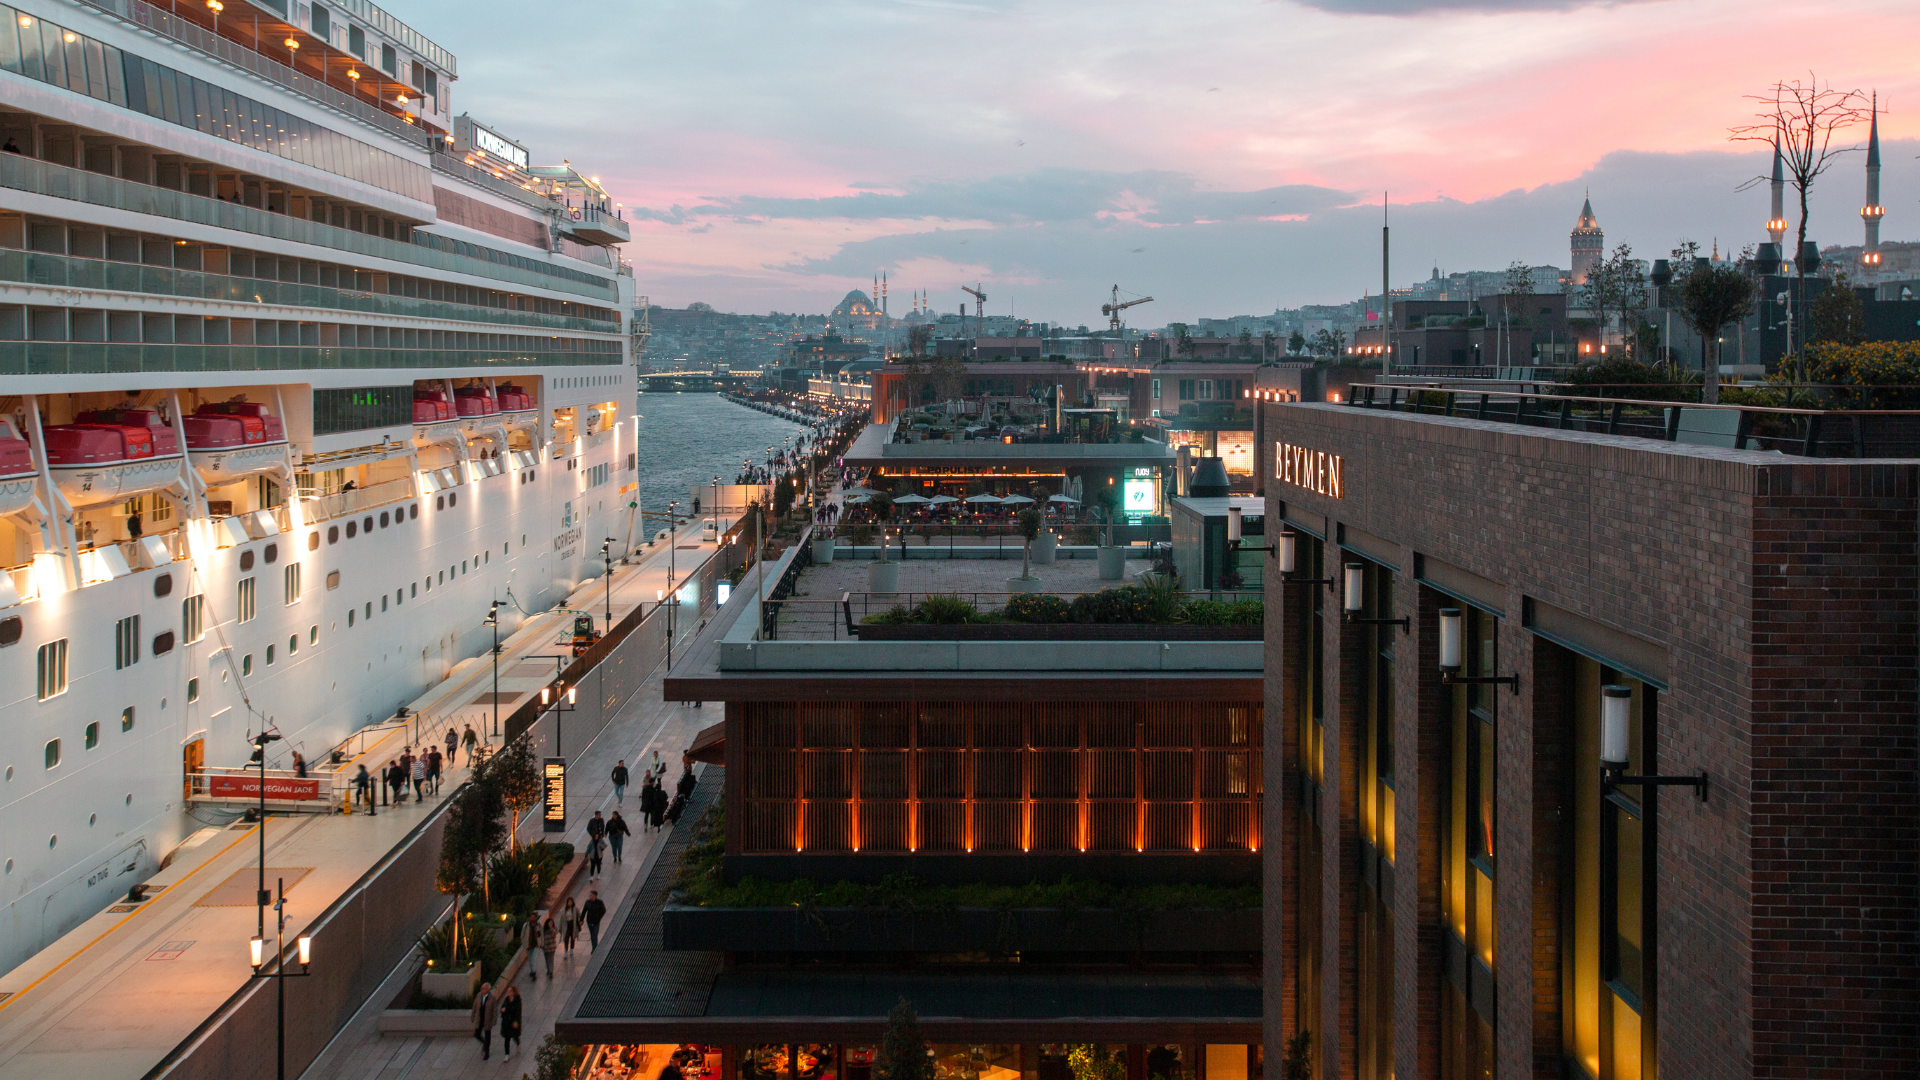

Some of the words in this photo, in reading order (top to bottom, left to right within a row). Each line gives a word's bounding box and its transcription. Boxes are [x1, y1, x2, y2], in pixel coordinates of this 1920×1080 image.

[928, 466, 982, 474] POPULIST
[1276, 441, 1341, 499] BEYMEN
[82, 483, 92, 492] 14
[554, 526, 582, 553] NORWEGIAN
[293, 786, 313, 794] JADE
[87, 875, 97, 889] NO
[97, 867, 109, 882] TUG
